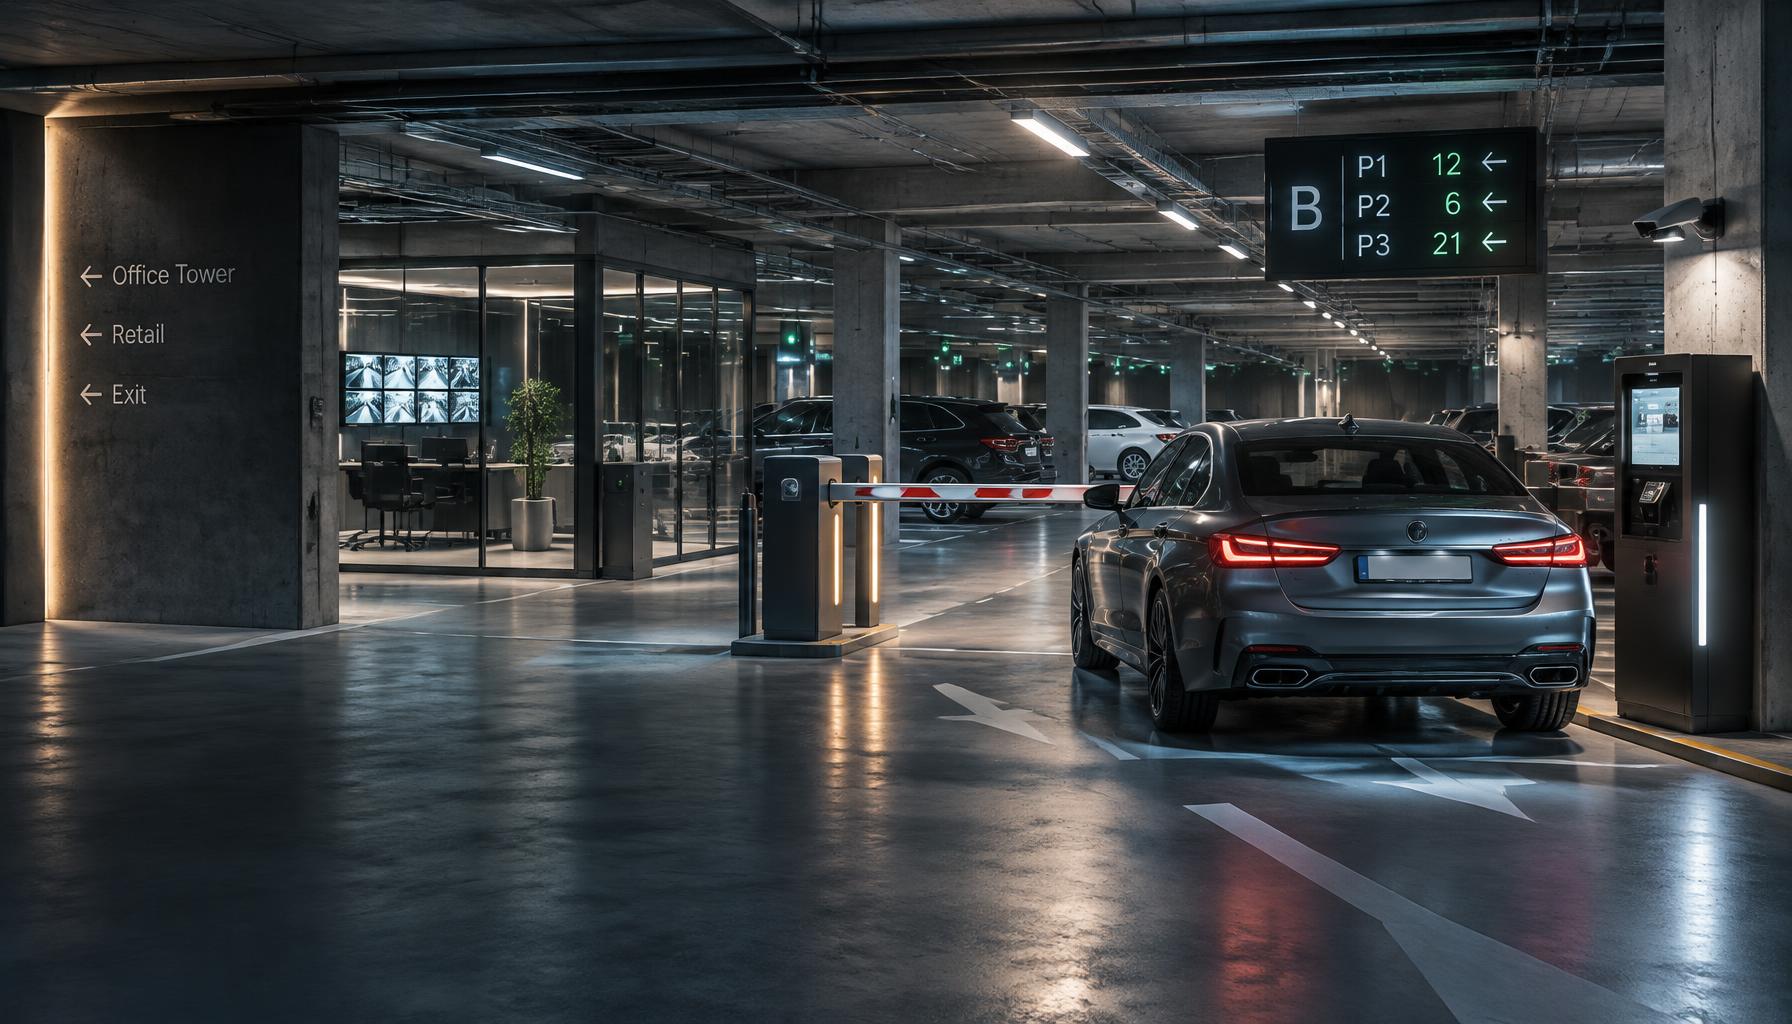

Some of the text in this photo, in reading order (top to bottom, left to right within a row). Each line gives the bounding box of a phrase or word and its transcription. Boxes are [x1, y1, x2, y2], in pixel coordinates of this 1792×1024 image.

[1358, 152, 1461, 178] P1 12
[1291, 185, 1323, 231] B
[1358, 191, 1461, 218] P2 6
[1358, 231, 1461, 257] P3 21
[112, 263, 235, 285] Office Tower
[112, 323, 165, 344] Retail
[112, 384, 147, 405] Exit
